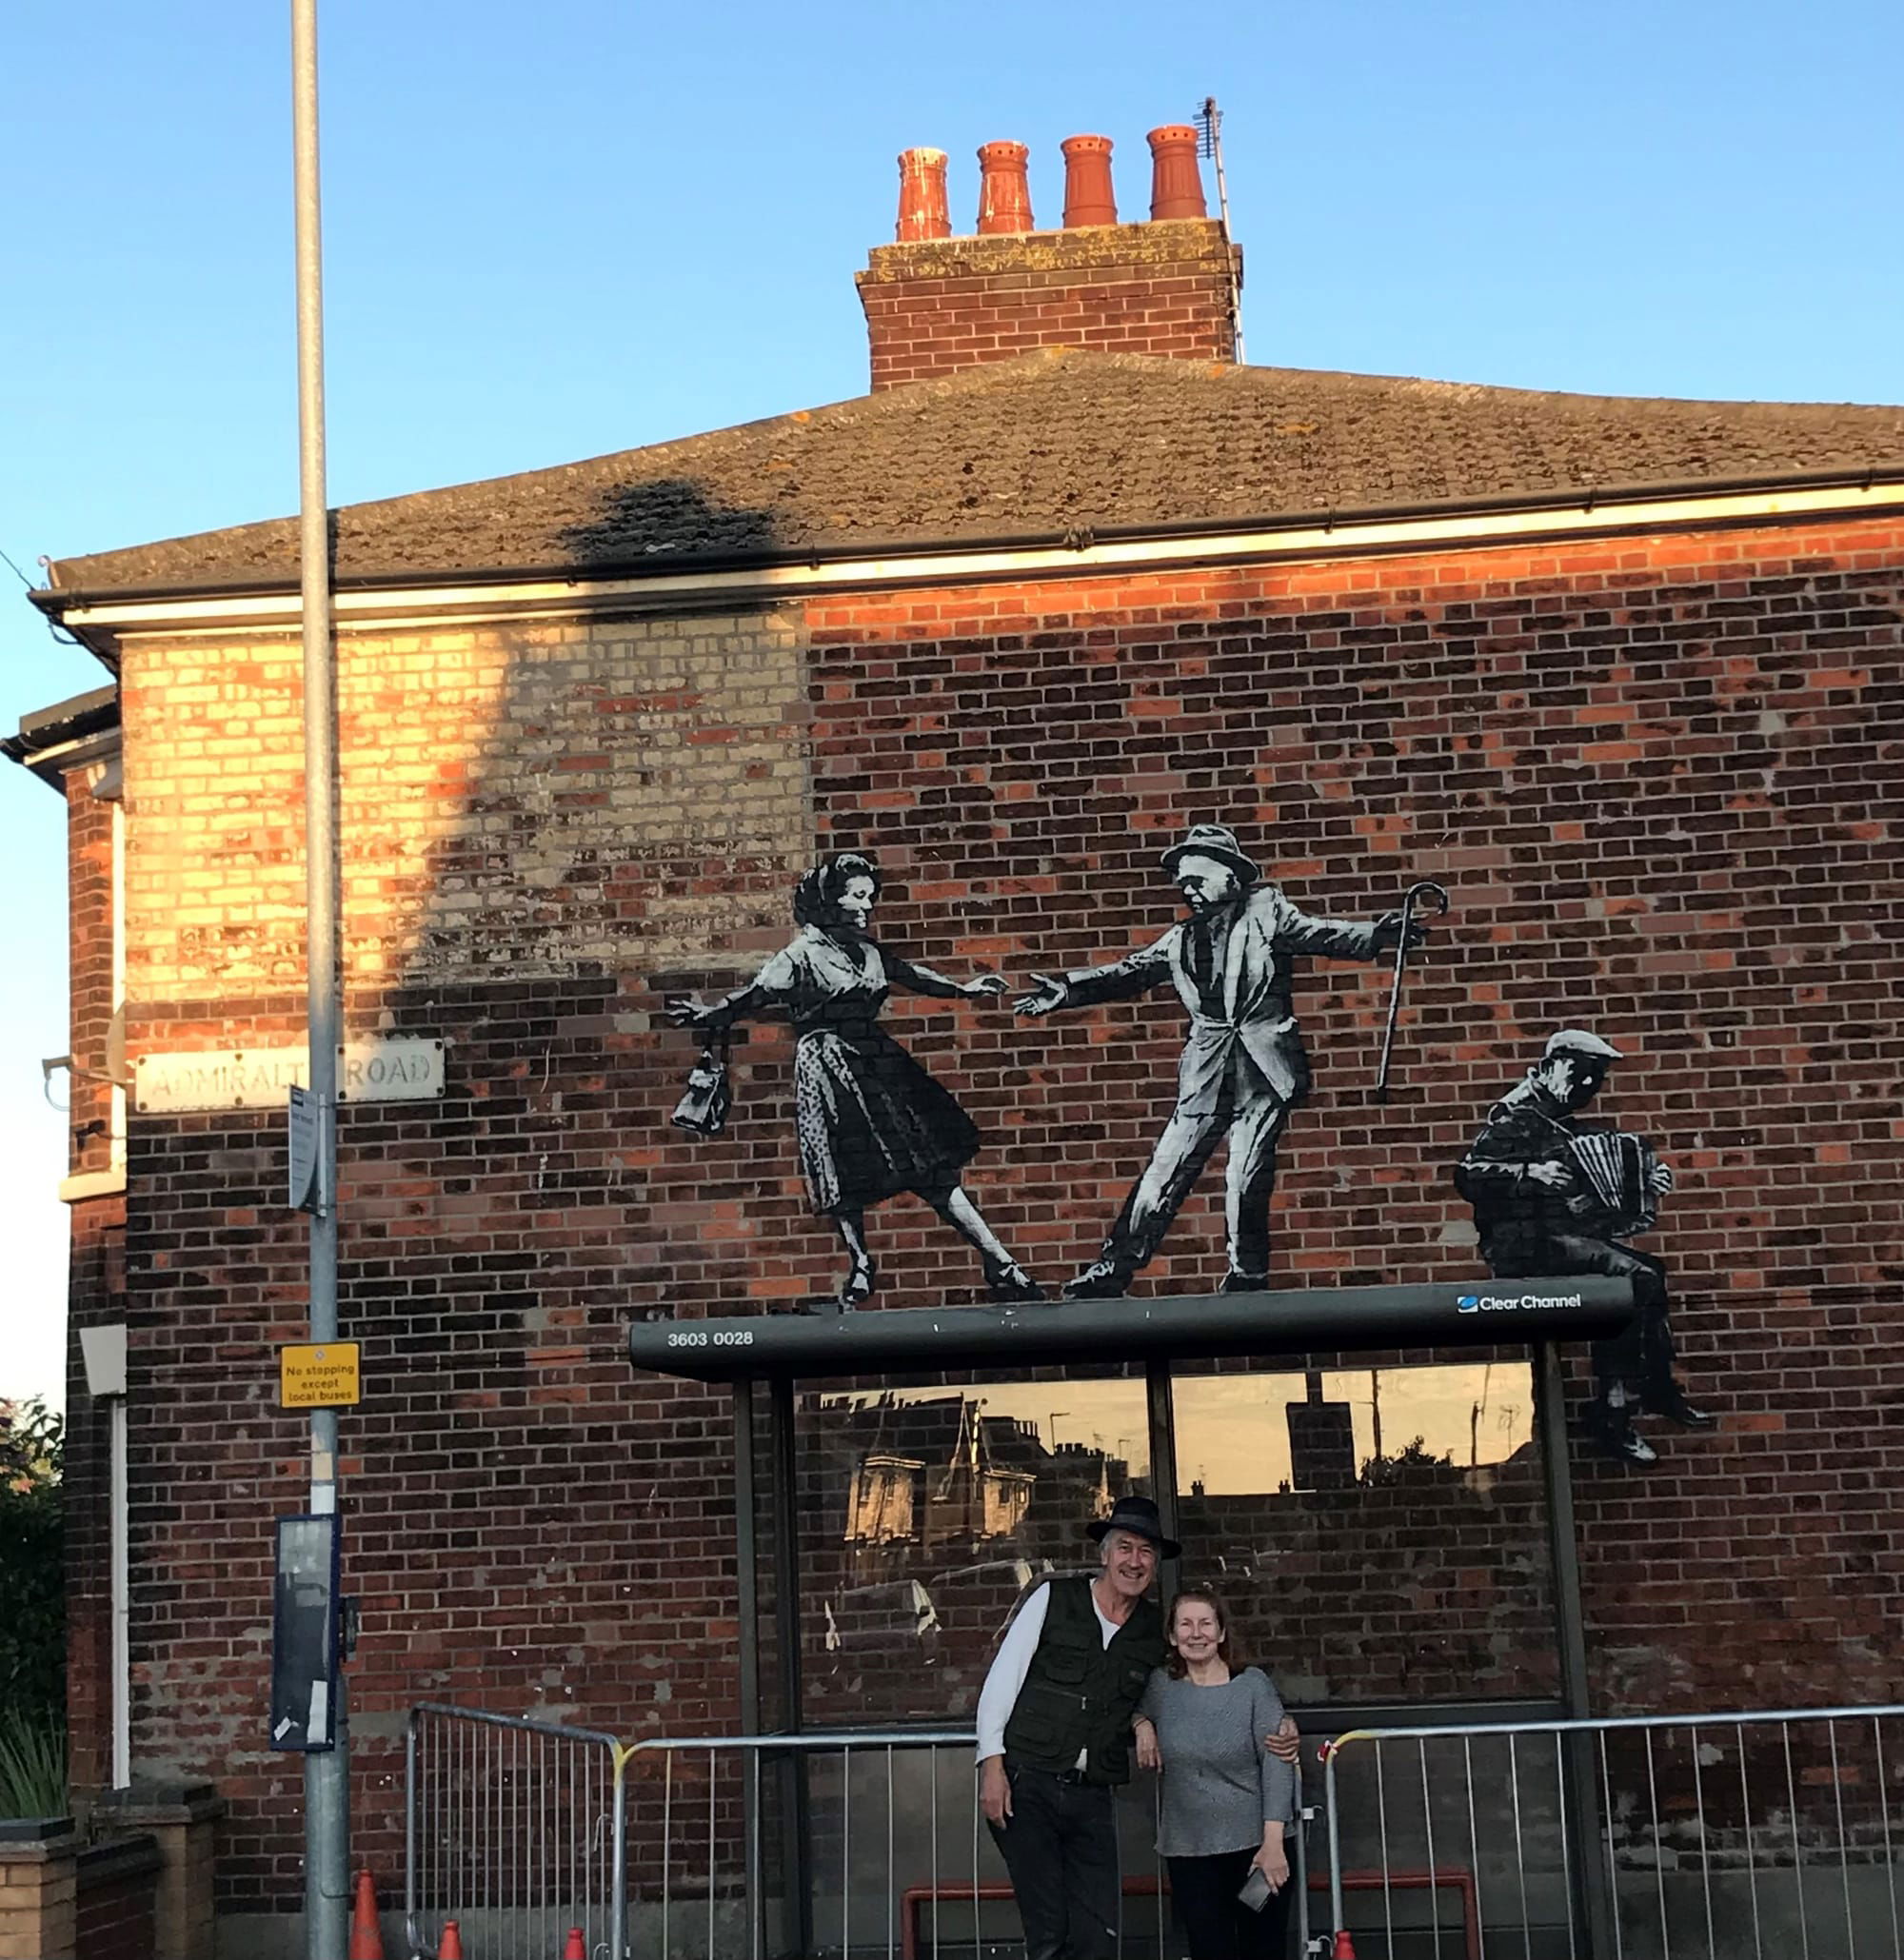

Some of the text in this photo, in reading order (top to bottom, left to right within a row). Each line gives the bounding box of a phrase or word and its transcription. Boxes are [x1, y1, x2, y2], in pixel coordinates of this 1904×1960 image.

[151, 1056, 430, 1096] ADMIRALT ROAD
[1479, 1294, 1581, 1311] Clear Channel
[667, 1332, 754, 1347] 3603 0028
[286, 1363, 355, 1376] No stopping
[301, 1378, 339, 1390] except
[288, 1391, 352, 1402] local buses
